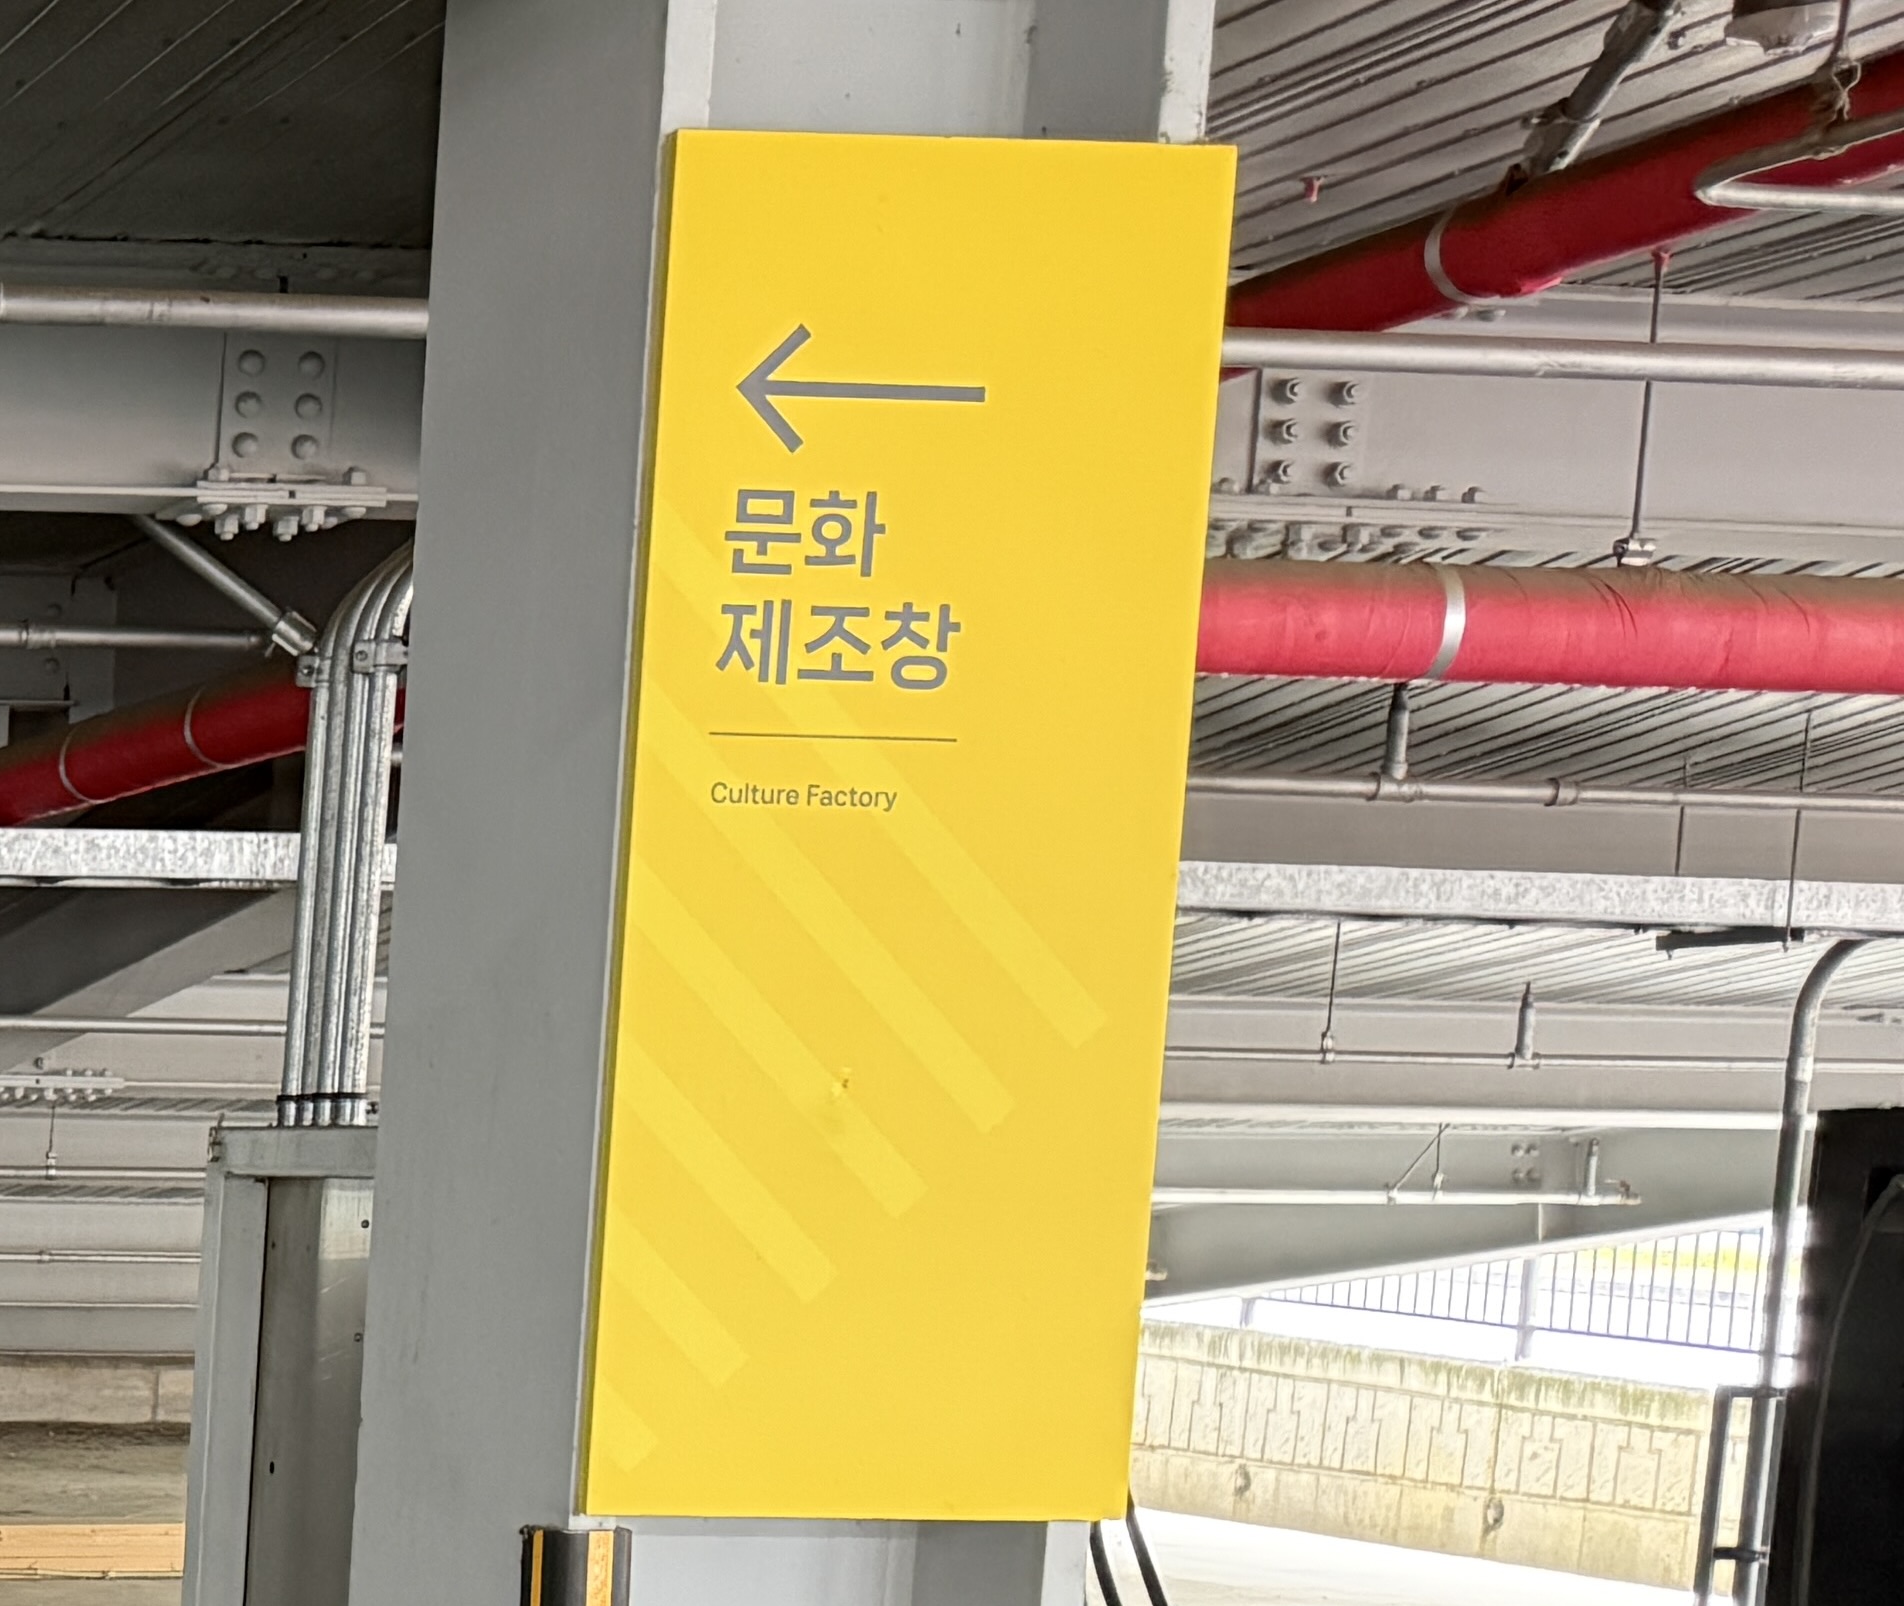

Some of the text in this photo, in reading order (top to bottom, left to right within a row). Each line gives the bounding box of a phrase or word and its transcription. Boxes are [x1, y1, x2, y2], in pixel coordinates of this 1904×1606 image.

[724, 488, 886, 578] 문화
[715, 598, 961, 690] 제조창
[710, 781, 898, 812] Culture Factory
